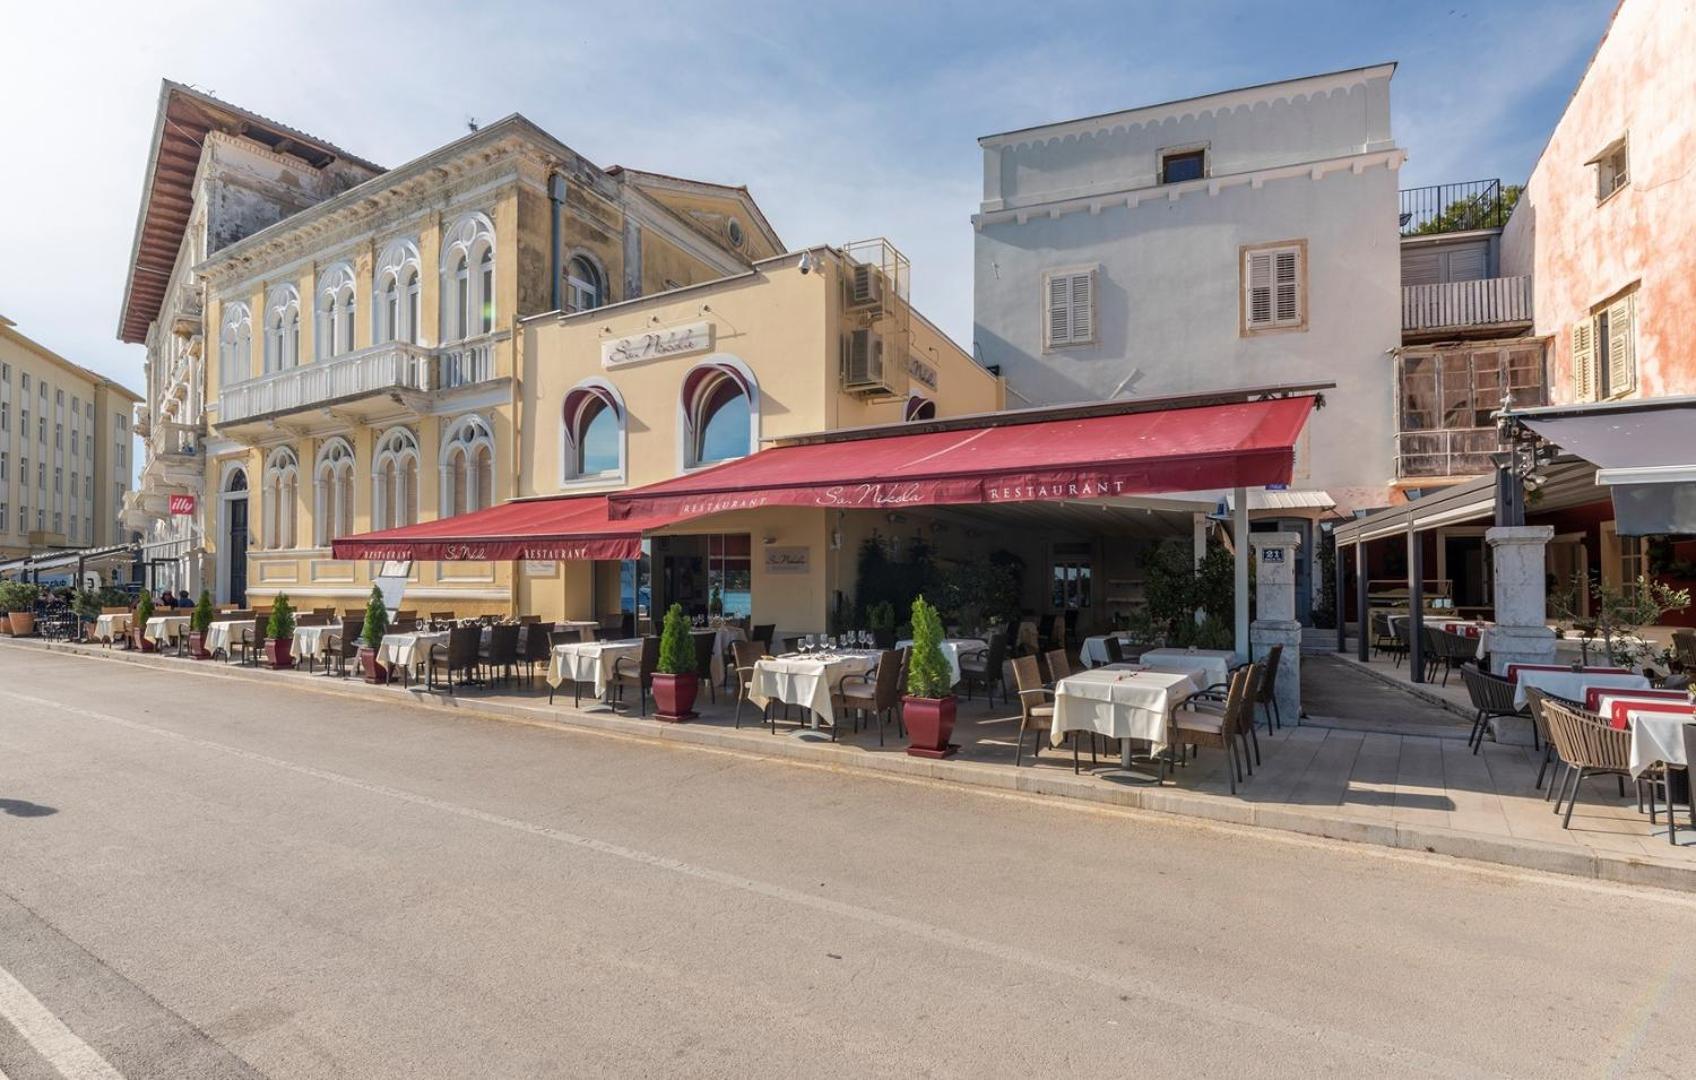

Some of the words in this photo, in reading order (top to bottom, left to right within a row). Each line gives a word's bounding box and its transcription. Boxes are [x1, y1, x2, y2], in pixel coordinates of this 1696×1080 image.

[683, 497, 767, 513] RESTAURANT
[991, 481, 1124, 499] RESTAURANT
[172, 497, 193, 513] illy
[363, 550, 412, 559] RESTAURANT
[524, 548, 586, 559] RESTAURANT
[1265, 550, 1280, 558] 21
